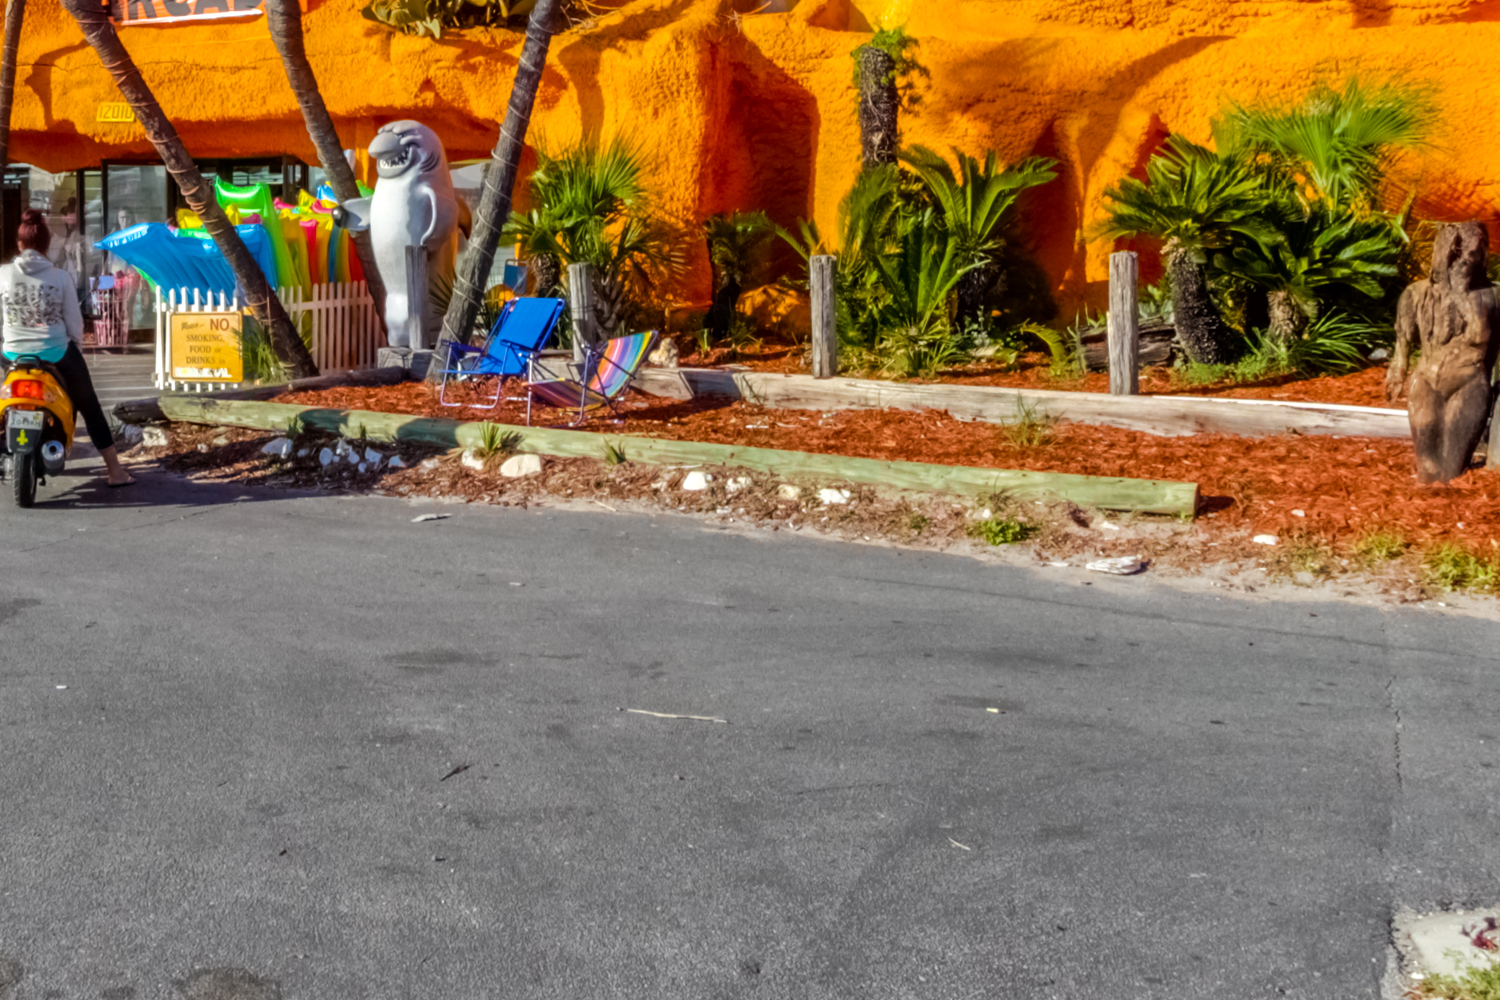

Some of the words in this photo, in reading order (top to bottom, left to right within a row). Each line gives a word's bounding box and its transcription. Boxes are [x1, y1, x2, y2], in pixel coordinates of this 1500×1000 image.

[99, 104, 133, 119] 12010
[209, 318, 230, 331] NO
[186, 334, 225, 343] SMOKING,
[189, 345, 211, 353] FOOD
[186, 356, 215, 364] DRINKS
